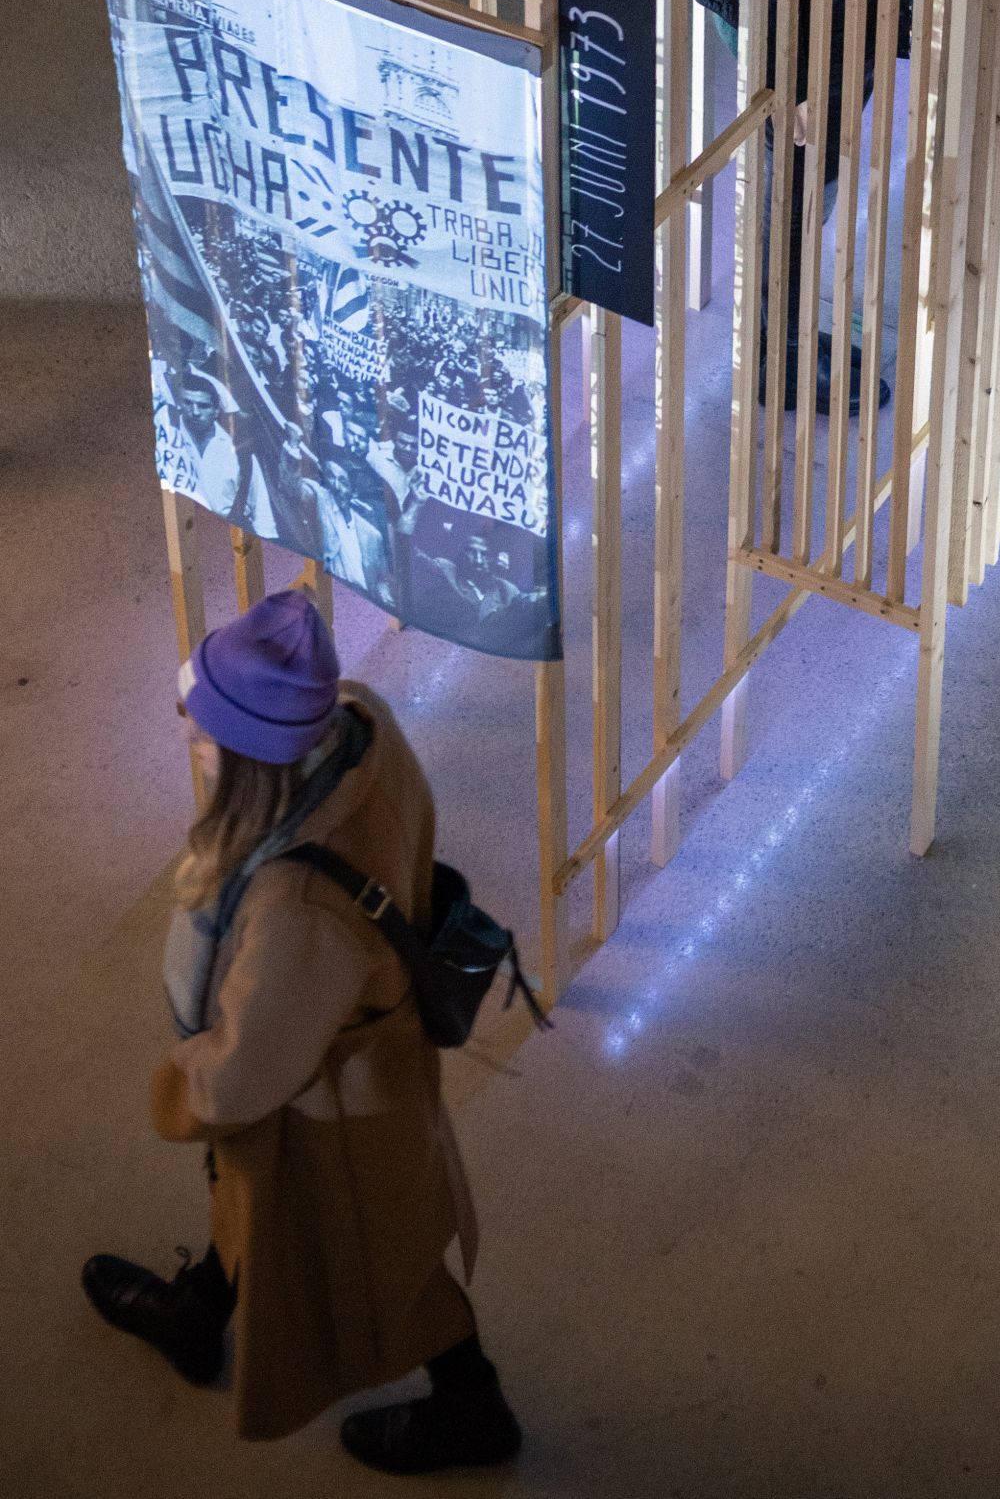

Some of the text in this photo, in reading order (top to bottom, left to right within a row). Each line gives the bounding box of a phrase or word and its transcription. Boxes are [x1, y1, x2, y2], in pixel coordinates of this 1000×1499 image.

[569, 6, 628, 115] 1973
[164, 27, 523, 217] PRESENTE
[570, 124, 628, 218] JUNI
[424, 472, 546, 534] LANASU
